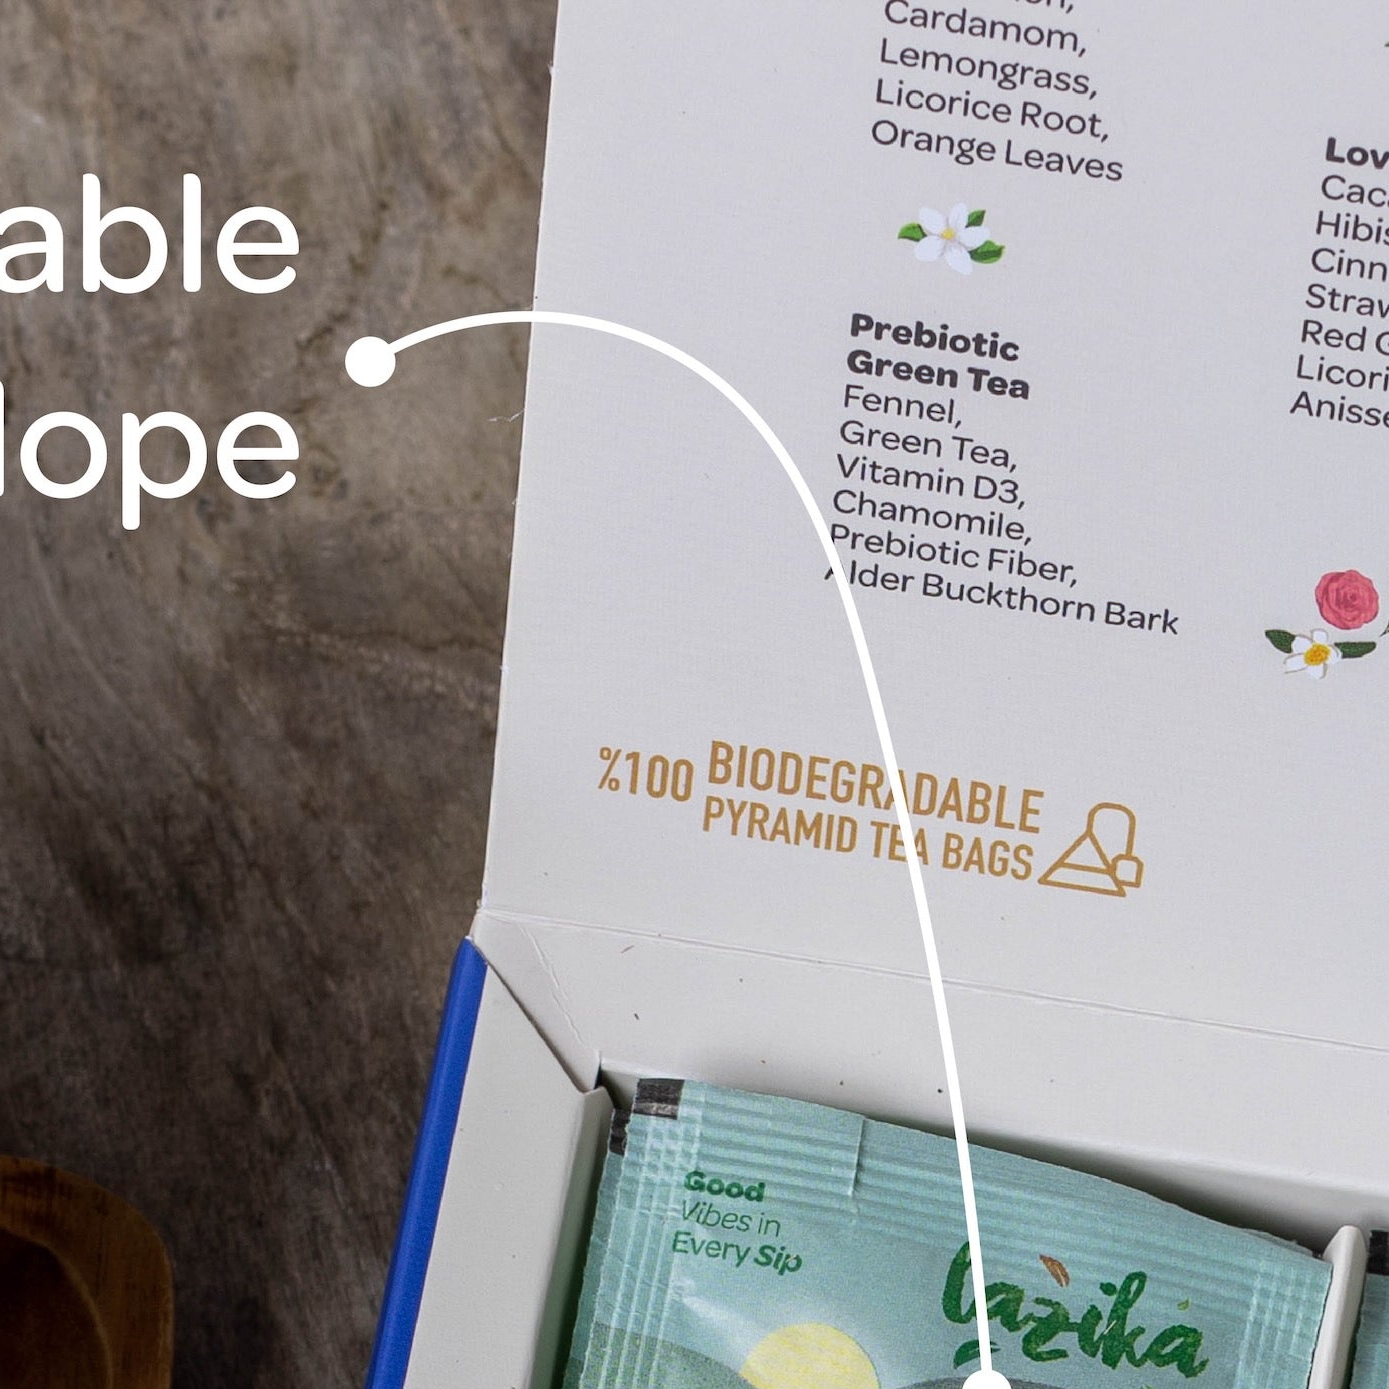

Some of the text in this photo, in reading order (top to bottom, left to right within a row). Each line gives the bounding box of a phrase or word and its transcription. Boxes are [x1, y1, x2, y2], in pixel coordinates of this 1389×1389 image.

[876, 78, 1108, 143] Licorice Root,
[872, 120, 1123, 182] Orange Leaves
[851, 313, 1019, 361] Prebiotic
[1301, 319, 1366, 352] Red
[847, 350, 1030, 400] Green Tea
[844, 384, 961, 429] Fennel,
[840, 420, 1016, 473] Green Tea,
[837, 454, 1025, 510] Vitamin D3,
[833, 489, 1031, 546] Chamomile,
[830, 523, 1077, 588] Prebiotic Fiber,
[824, 560, 1179, 635] lder Buckthorn Bark
[598, 747, 693, 802] %100
[703, 796, 857, 852] PYRAMID
[942, 833, 1033, 880] BAGS
